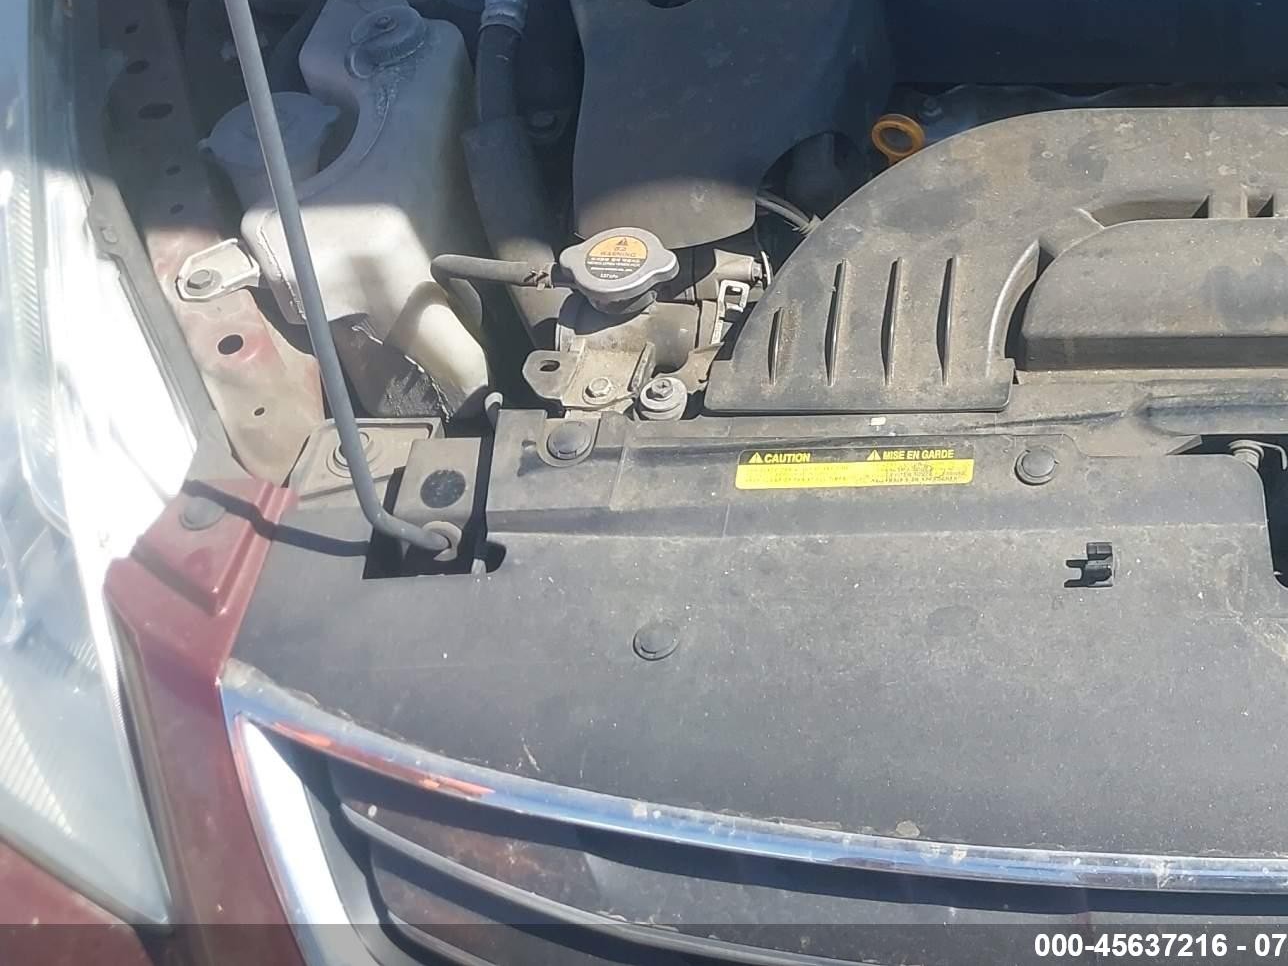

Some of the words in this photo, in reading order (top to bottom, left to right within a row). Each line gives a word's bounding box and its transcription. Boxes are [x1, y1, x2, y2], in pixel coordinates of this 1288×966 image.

[764, 452, 811, 464] CAUTION
[882, 450, 906, 461] MISE
[906, 450, 920, 460] EN
[921, 449, 955, 460] GARDE
